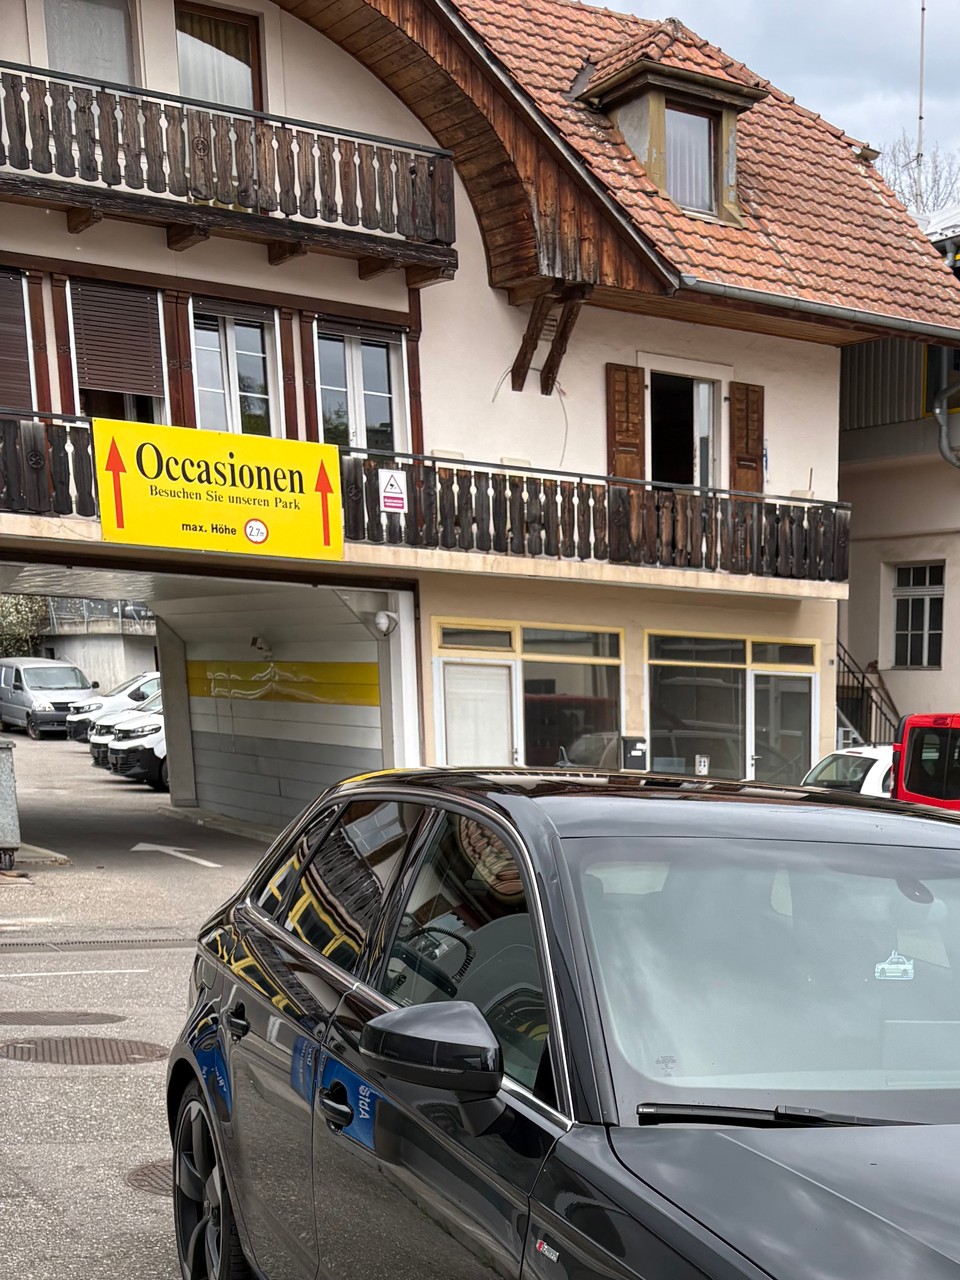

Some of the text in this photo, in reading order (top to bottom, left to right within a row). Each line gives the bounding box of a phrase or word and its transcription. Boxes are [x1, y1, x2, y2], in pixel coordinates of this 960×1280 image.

[136, 442, 305, 494] Occasionen
[150, 484, 301, 510] Besuchen Sie unseren Park
[181, 523, 237, 535] max. Höhe
